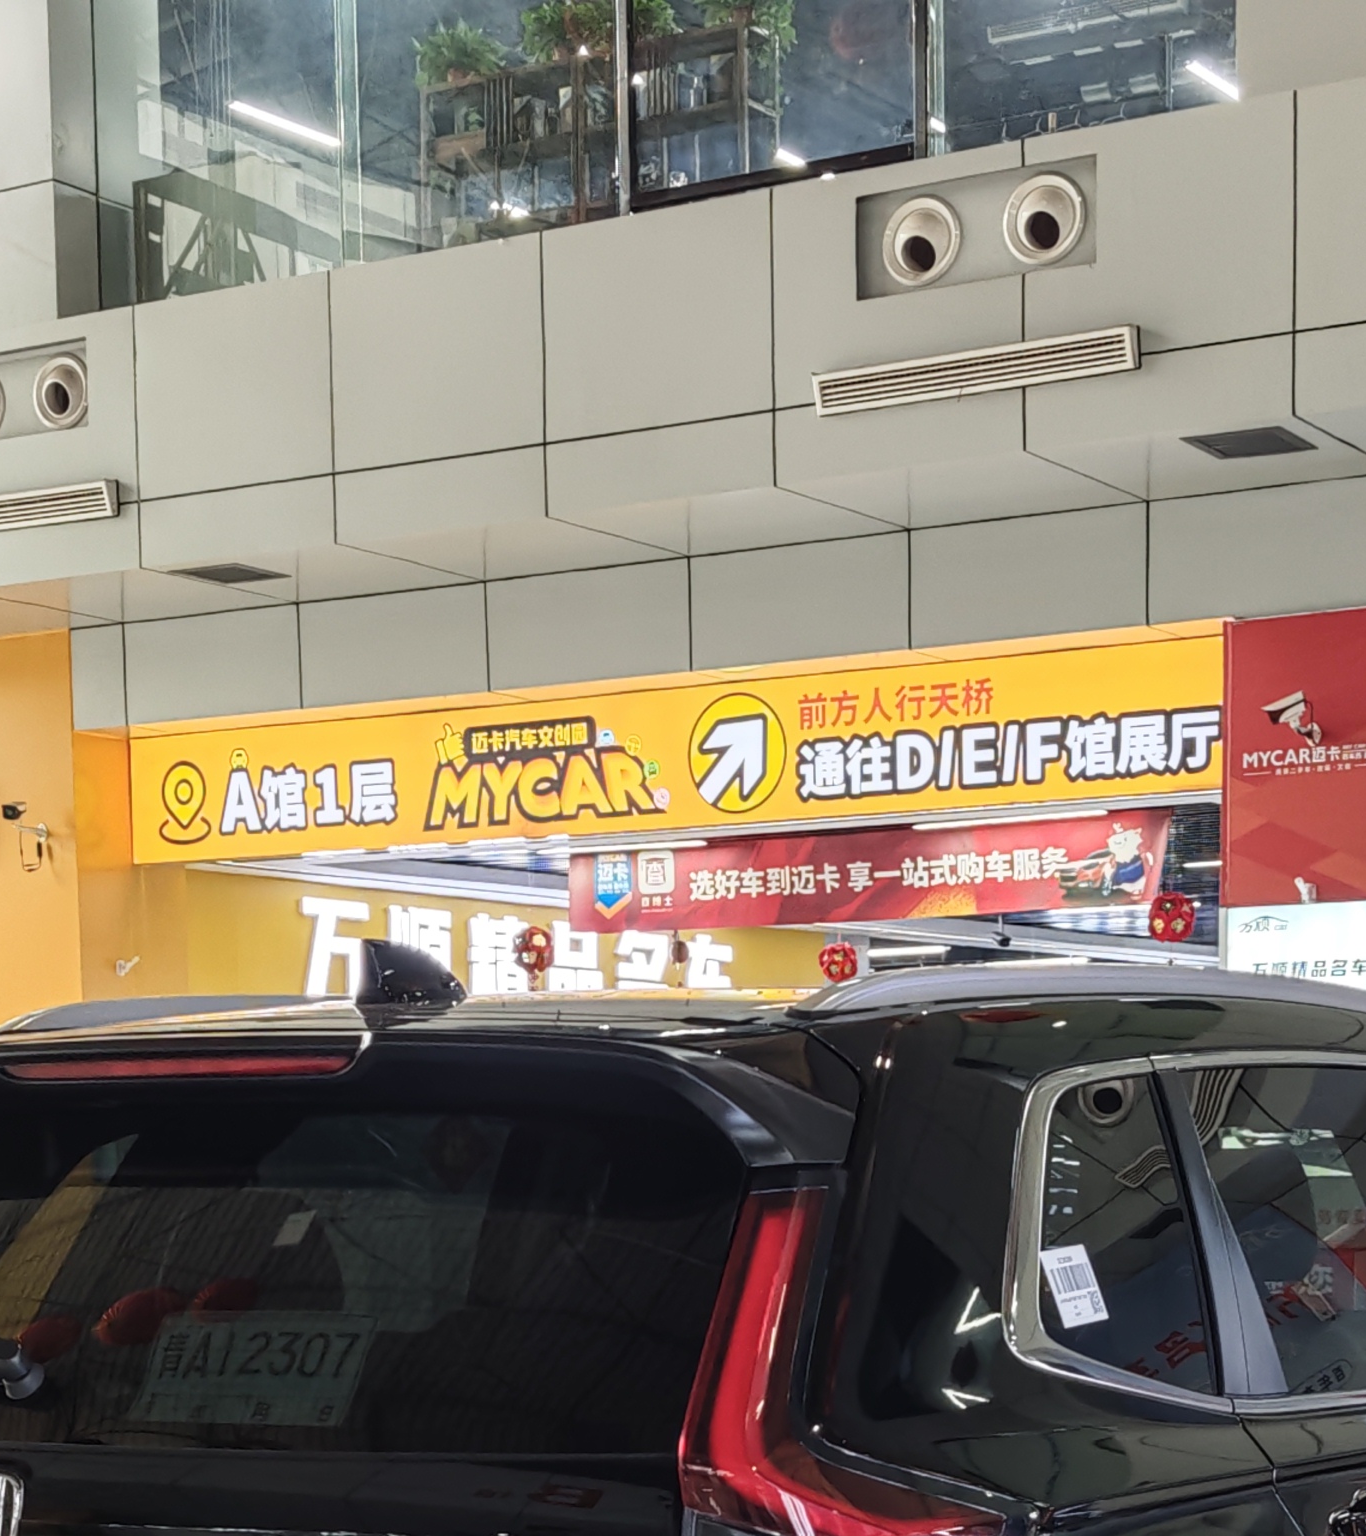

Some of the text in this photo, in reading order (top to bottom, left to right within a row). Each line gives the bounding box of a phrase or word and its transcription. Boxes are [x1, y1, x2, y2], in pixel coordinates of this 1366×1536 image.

[798, 678, 994, 730] 前方人行天桥
[471, 722, 588, 754] 迈卡汽车文创园
[800, 710, 1221, 798] 通往D/E/F馆展厅
[220, 761, 397, 834] A馆1层
[427, 753, 653, 829] MYCAR
[689, 848, 1063, 902] 选好车到迈卡 享一站式购车服务
